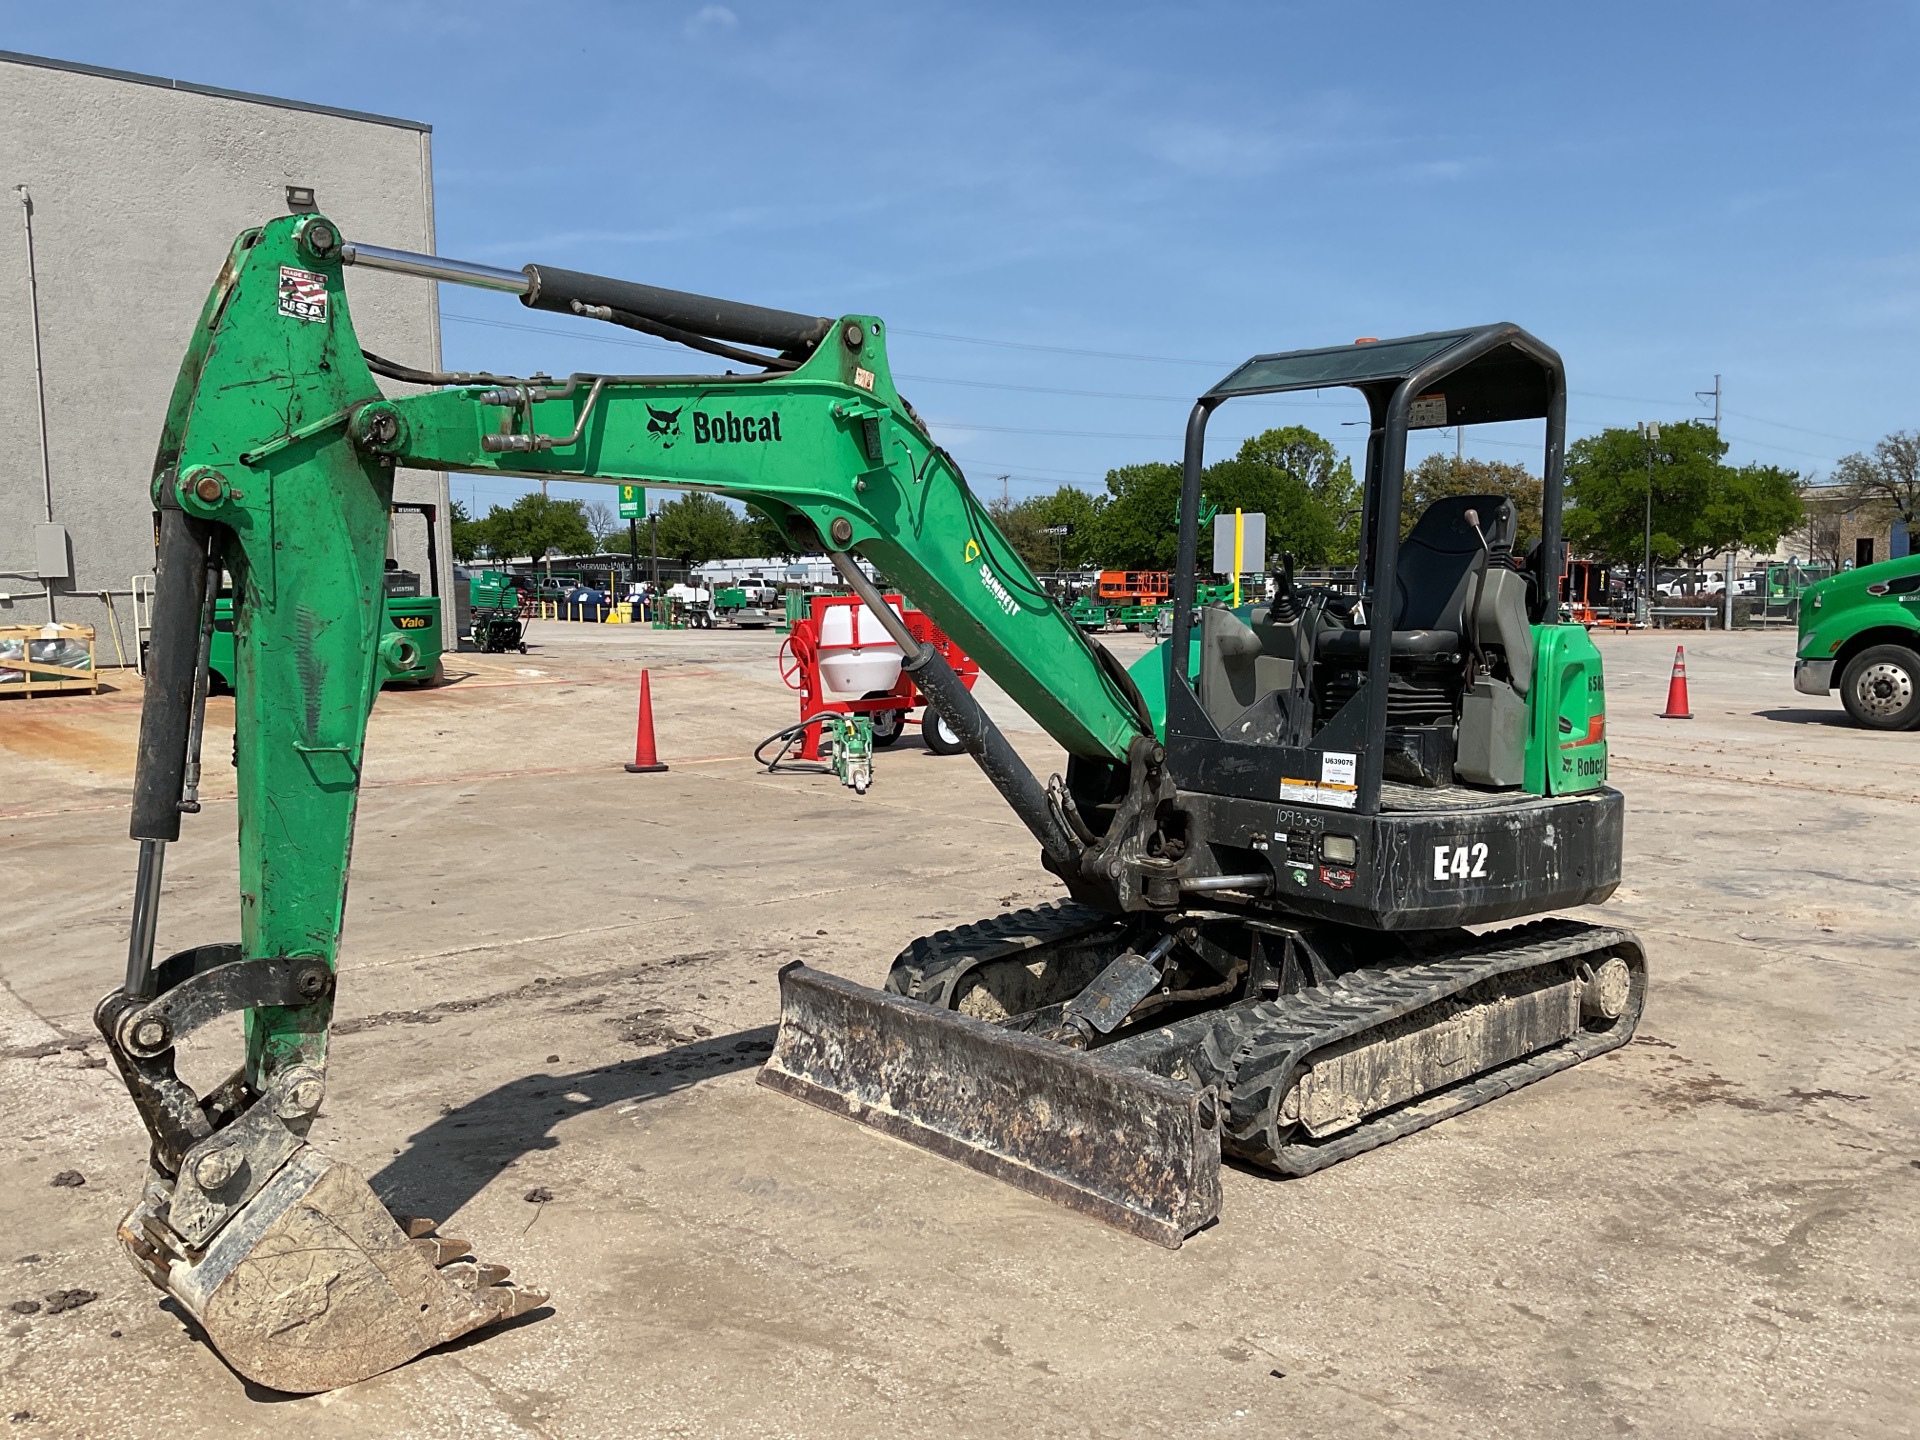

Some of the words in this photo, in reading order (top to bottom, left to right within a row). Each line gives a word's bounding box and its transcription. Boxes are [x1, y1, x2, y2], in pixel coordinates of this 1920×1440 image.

[283, 269, 303, 278] MADE
[282, 299, 324, 318] USA
[692, 411, 782, 444] Bobcat
[400, 617, 425, 628] Yale
[1577, 755, 1605, 777] Bobca
[1433, 842, 1489, 881] E42
